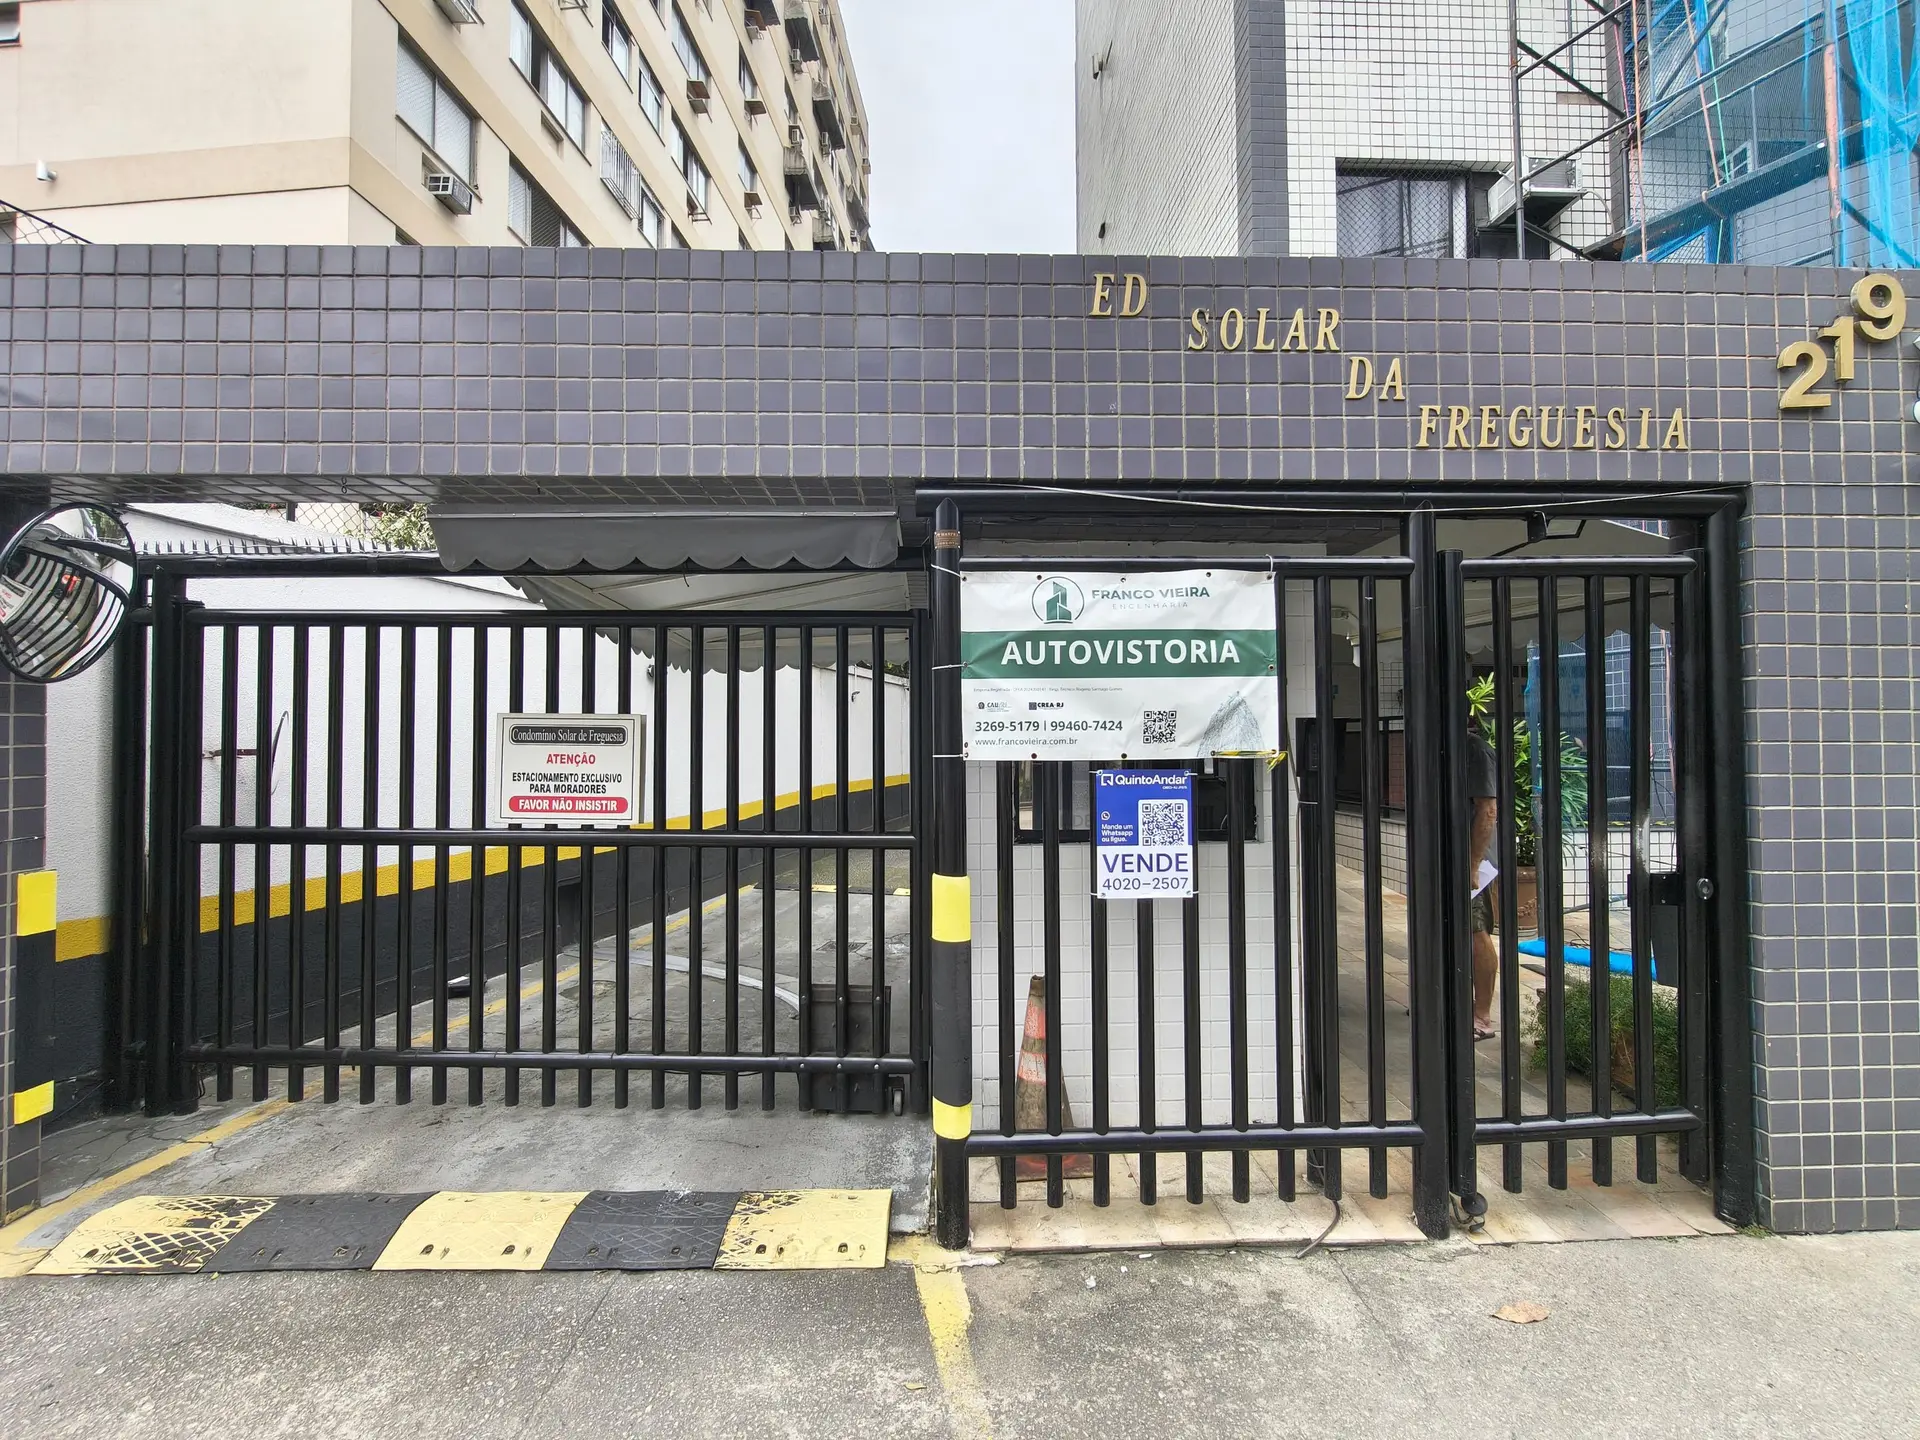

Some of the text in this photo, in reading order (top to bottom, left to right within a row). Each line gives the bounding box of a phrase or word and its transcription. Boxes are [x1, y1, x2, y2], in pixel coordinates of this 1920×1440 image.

[1089, 273, 1147, 317] ED
[1188, 307, 1340, 351] SOLAR
[1777, 273, 1907, 410] 219
[1345, 356, 1406, 400] DA
[1415, 405, 1689, 449] FREGUESIA
[1091, 586, 1210, 600] FRANCO VIEIRA
[1001, 639, 1240, 666] AUTOVISTORIA
[975, 721, 1040, 732] 3269-5179
[1050, 720, 1123, 731] 99460-7424
[557, 729, 577, 741] Solar
[578, 729, 588, 741] de
[588, 729, 624, 744] Freguesia
[975, 737, 1078, 746] www.francovieira.com.br
[546, 752, 596, 767] ATENÇÃO
[512, 772, 622, 783] ESTACIONAMENTO EXCLUSIVO
[1115, 774, 1188, 786] QuintoAndar
[529, 783, 607, 794] PARA MORADORES
[519, 797, 617, 811] FAVOR NÃO INSISTIR
[1102, 853, 1188, 873] VENDE
[1102, 877, 1188, 890] 4020-2507
